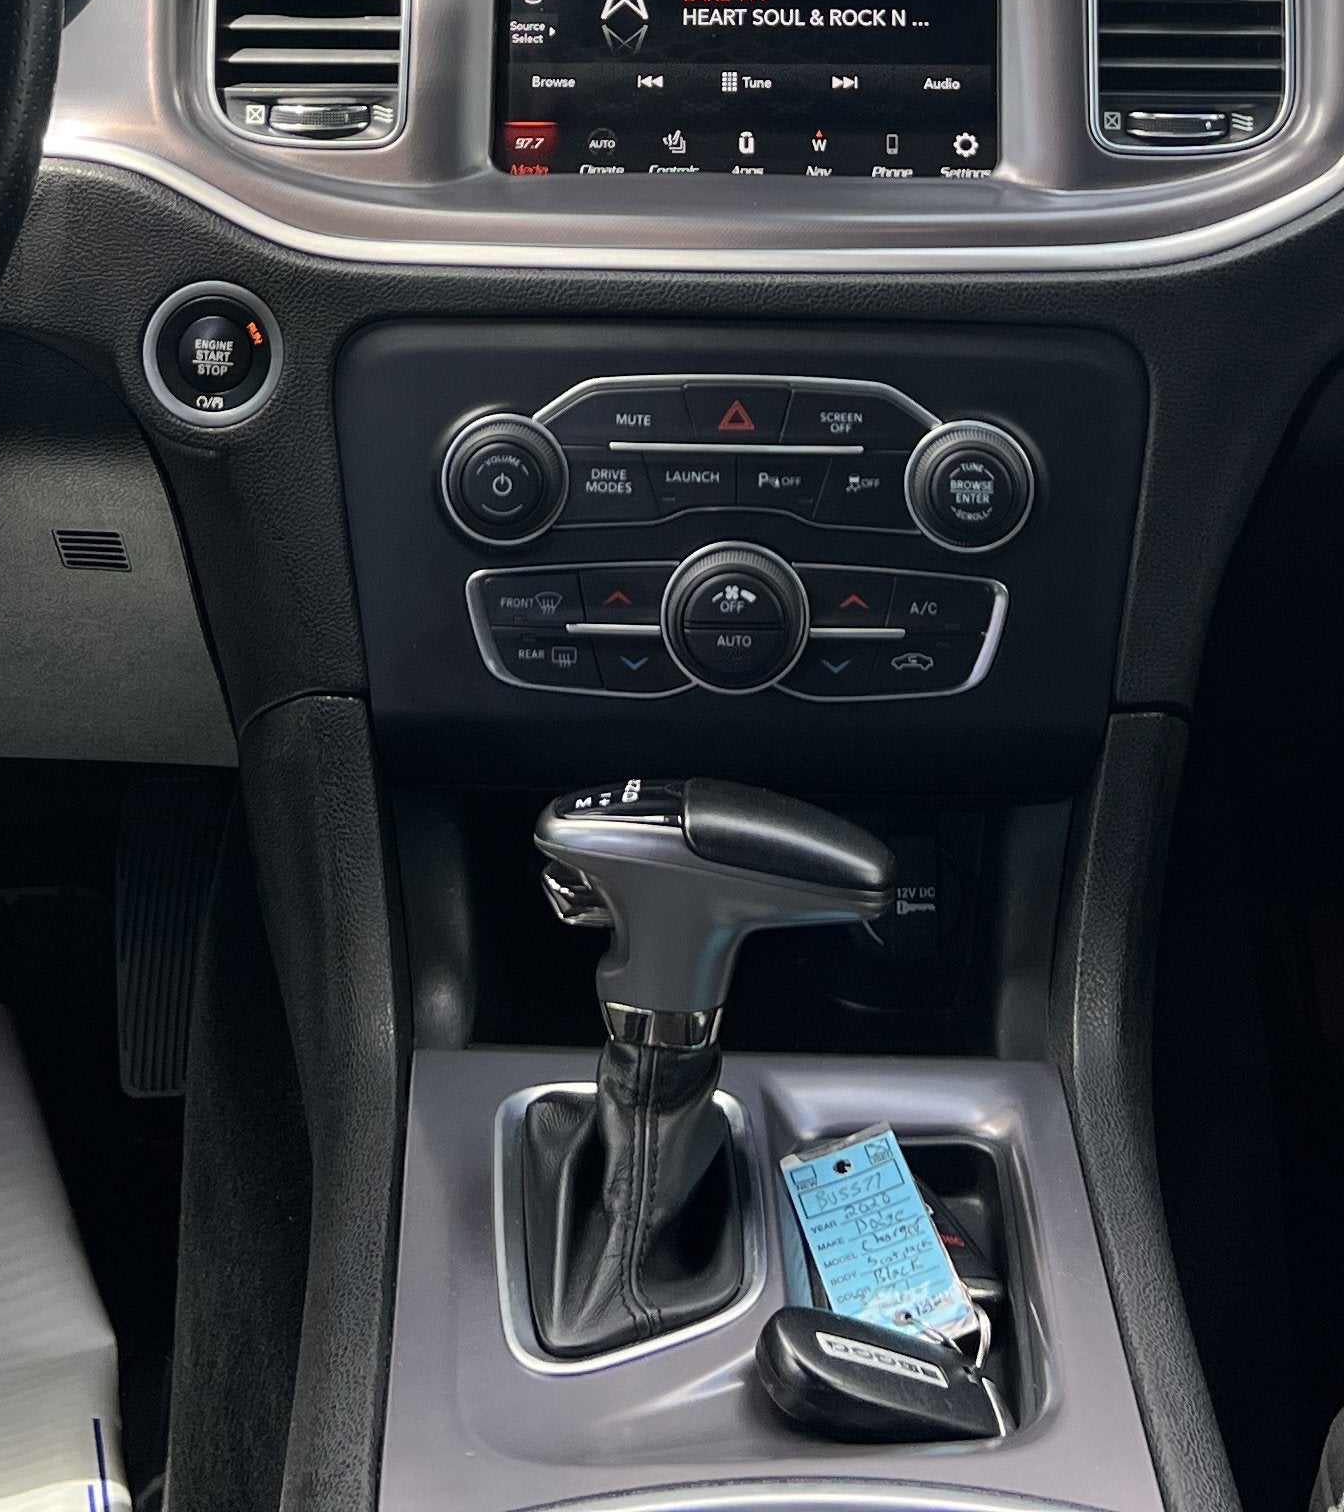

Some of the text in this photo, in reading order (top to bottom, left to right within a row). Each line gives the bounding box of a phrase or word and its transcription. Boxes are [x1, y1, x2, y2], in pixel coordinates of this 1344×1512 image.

[682, 8, 748, 27] HEART
[752, 8, 806, 27] SOUL
[809, 9, 825, 27] &
[829, 9, 887, 27] ROCK
[891, 9, 907, 27] N
[509, 20, 546, 32] Source
[511, 33, 544, 44] Select
[531, 75, 576, 88] Browse
[742, 76, 773, 89] Tune
[923, 77, 961, 90] Audio
[514, 137, 545, 150] 97.7
[588, 139, 616, 149] AUTO
[806, 165, 833, 177] Nav
[194, 338, 234, 351] ENGINE
[195, 349, 232, 362] START
[197, 364, 228, 376] STOP
[615, 413, 652, 426] MUTE
[819, 411, 864, 423] SCREEN
[829, 422, 852, 433] OFF
[484, 454, 522, 467] VOLUME
[960, 462, 985, 473] TUNE
[590, 468, 628, 481] DRIVE
[665, 470, 721, 484] LAUNCH
[781, 475, 802, 487] OFF
[585, 481, 633, 494] MODES
[861, 477, 881, 488] OFF
[949, 479, 994, 490] BROWSE
[955, 492, 990, 504] ENTER
[500, 596, 535, 609] FRONT
[719, 600, 745, 614] OFF
[909, 600, 938, 616] A/C
[716, 634, 753, 648] AUTO
[517, 648, 546, 661] REAR
[896, 886, 936, 899] 12V DC
[810, 1220, 838, 1234] YEAR
[817, 1238, 845, 1252] MAKE
[823, 1253, 859, 1269] MODEL
[830, 1272, 857, 1287] BODY
